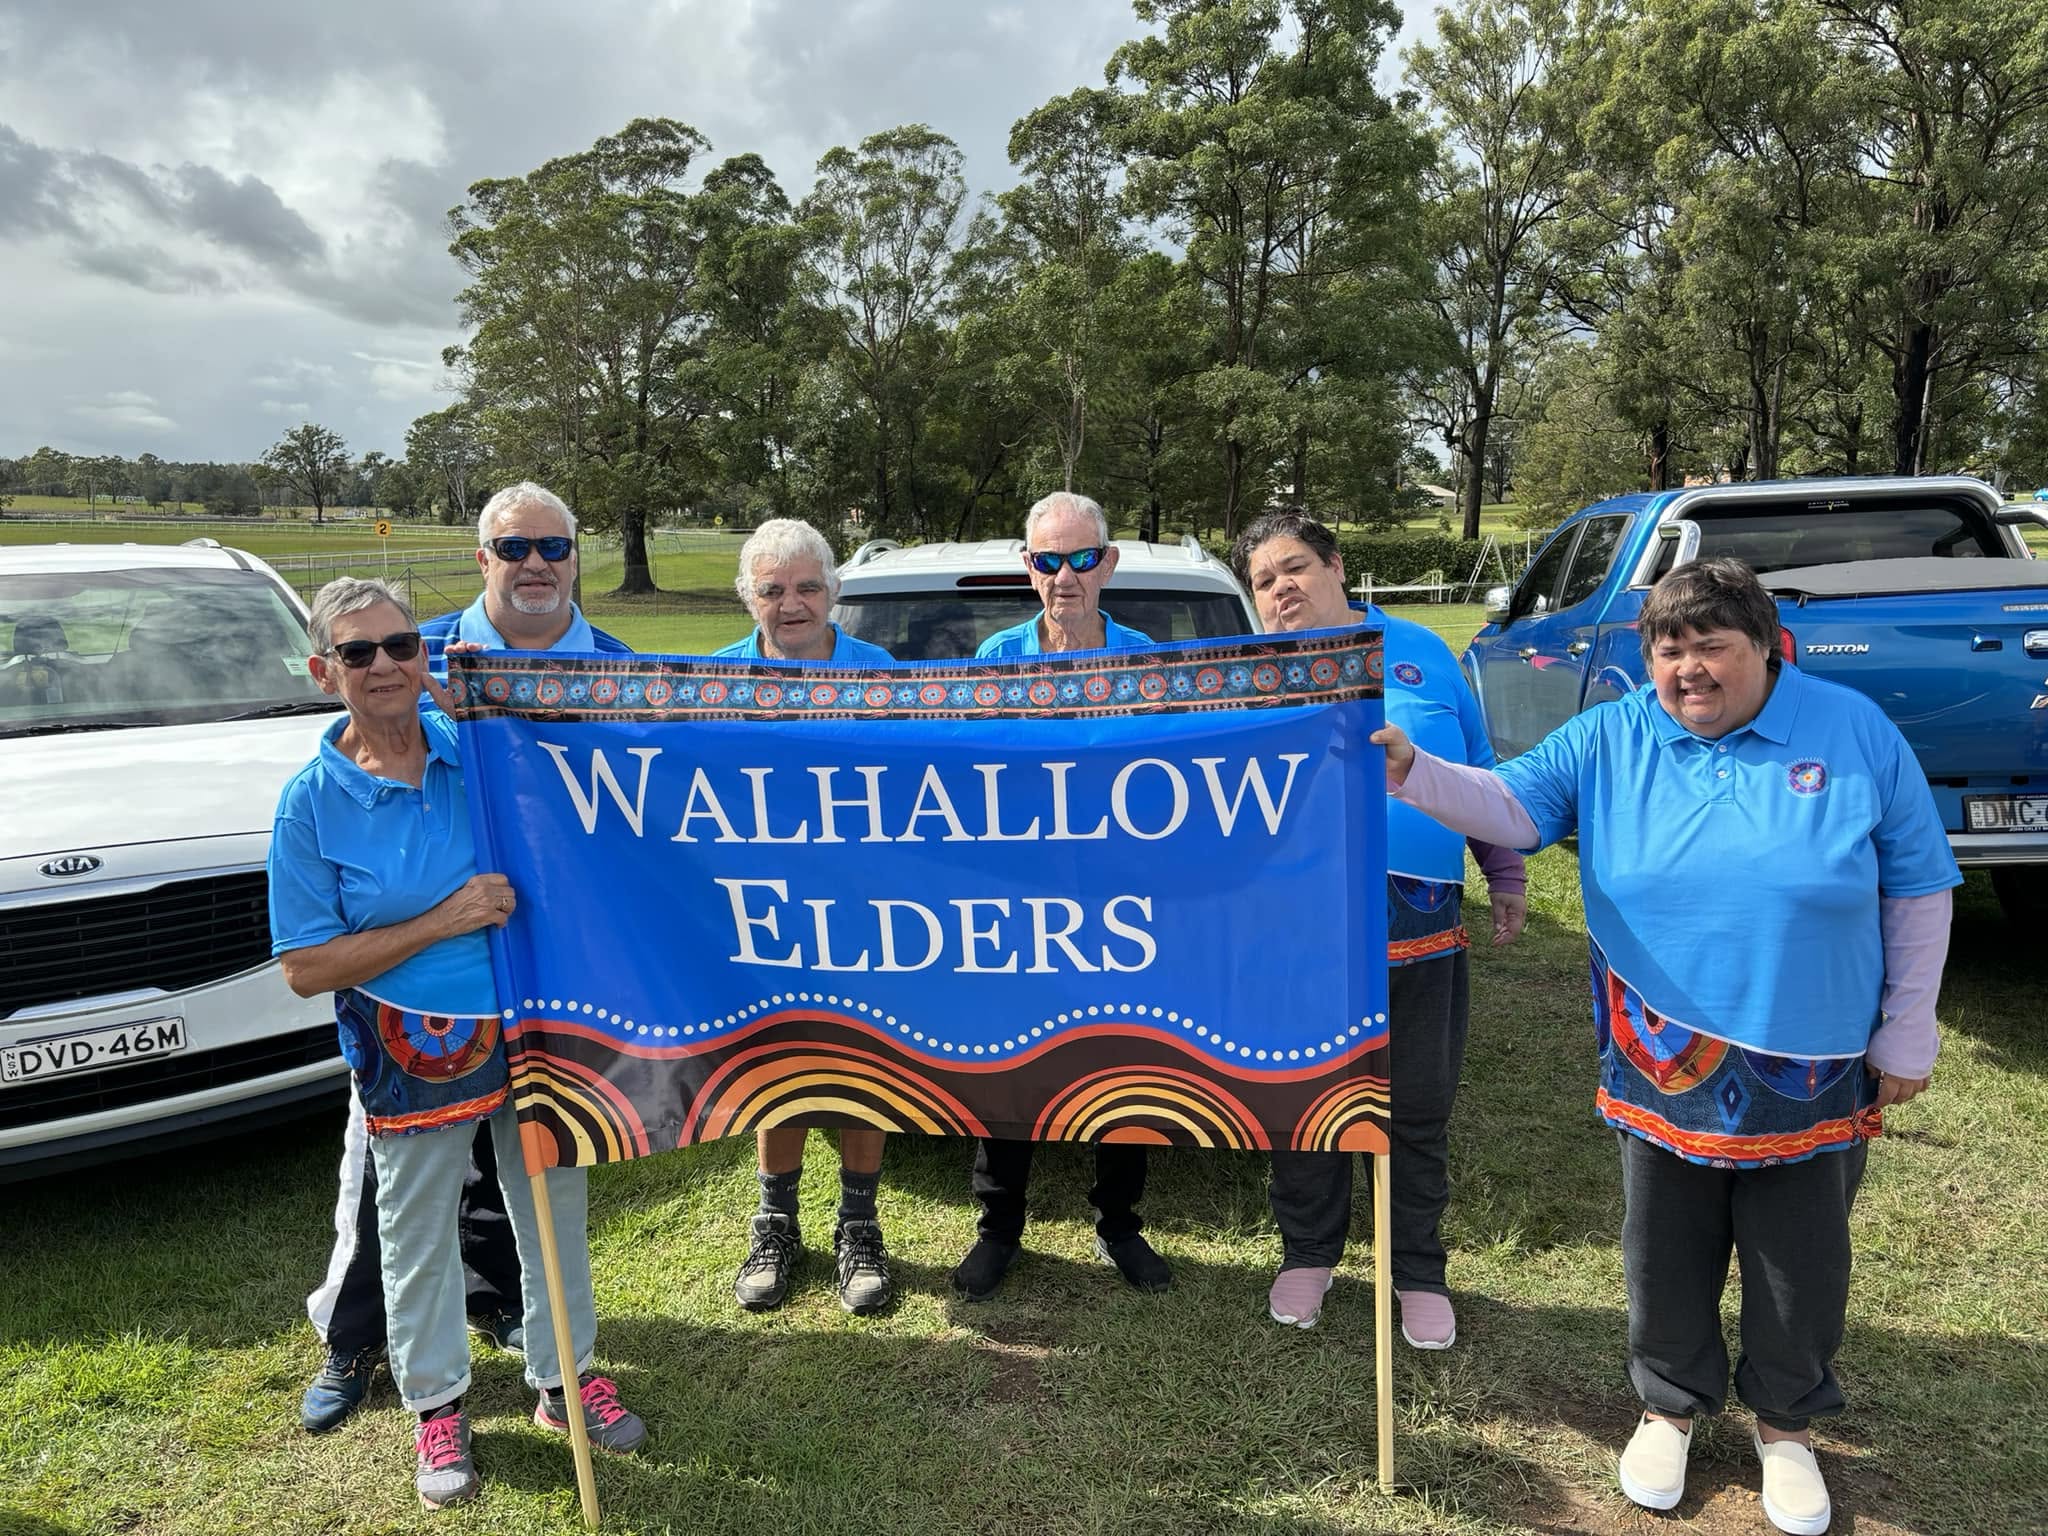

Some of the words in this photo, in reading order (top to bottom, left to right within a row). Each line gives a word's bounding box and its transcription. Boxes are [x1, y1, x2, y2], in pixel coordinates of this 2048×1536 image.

[379, 523, 387, 535] 2
[1806, 643, 1870, 655] TRITON
[537, 741, 1309, 844] WALHALLOW
[49, 857, 94, 873] KIA
[714, 878, 1157, 974] ELDERS
[7, 1052, 19, 1078] NSW
